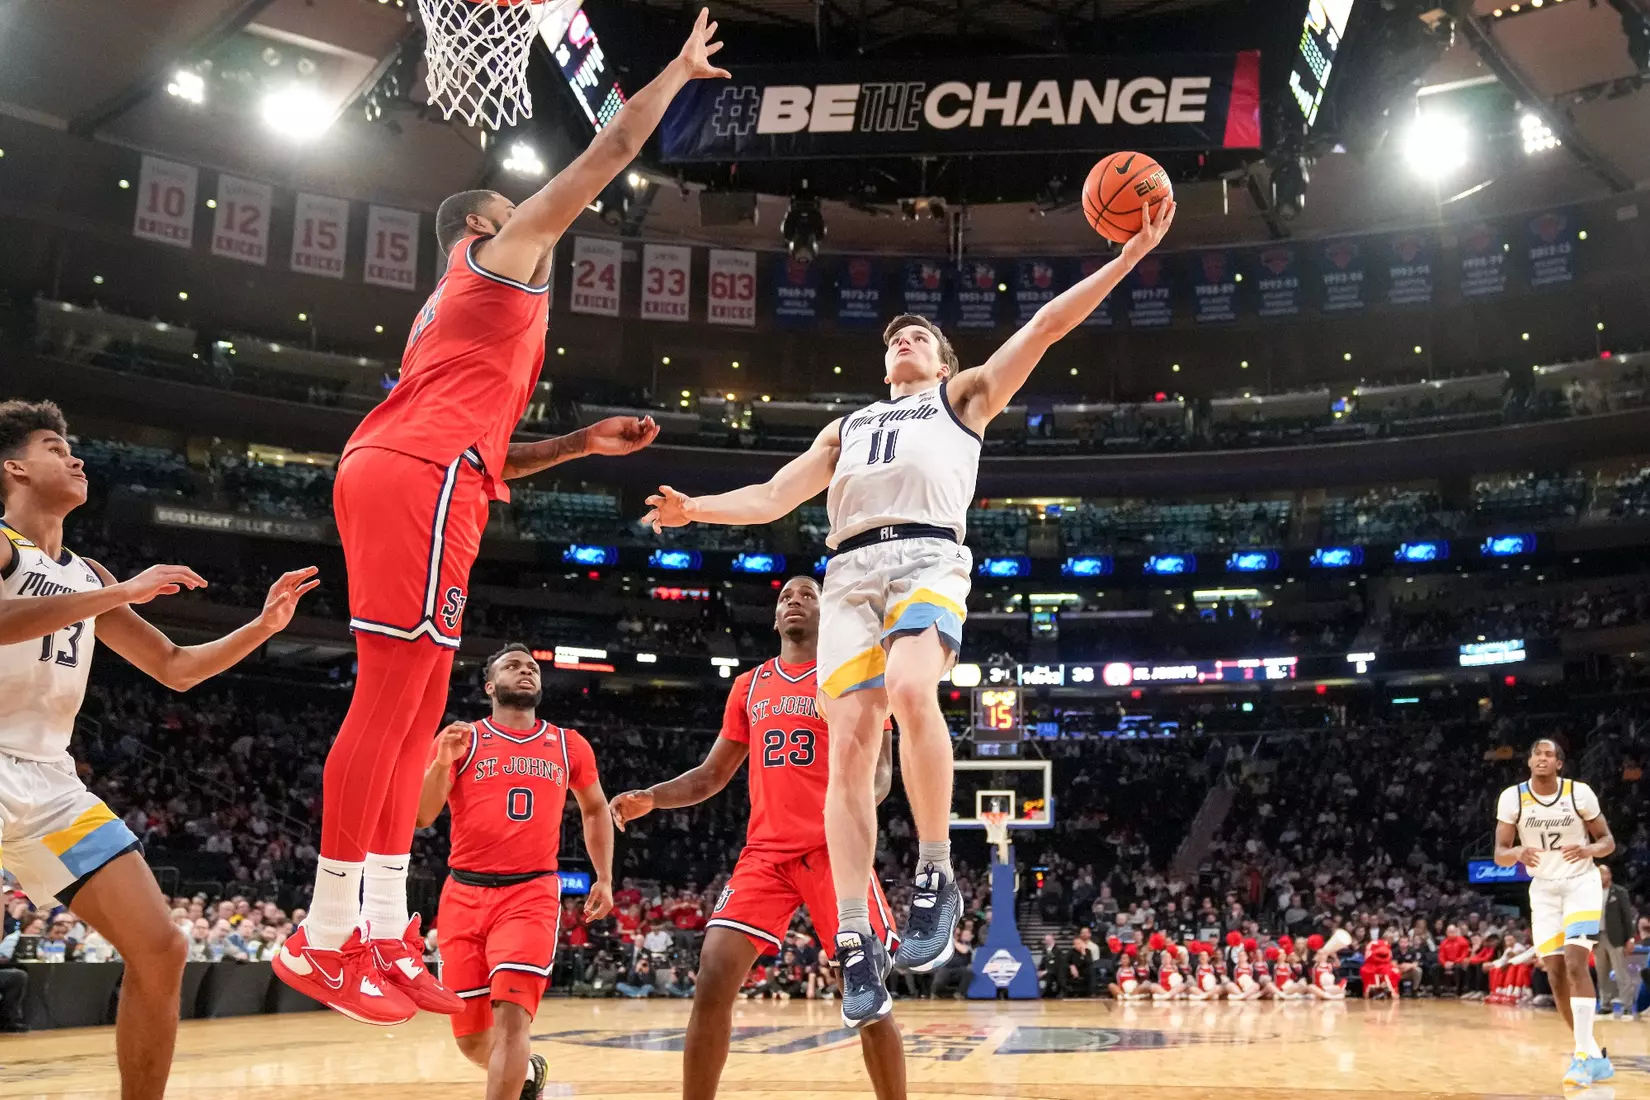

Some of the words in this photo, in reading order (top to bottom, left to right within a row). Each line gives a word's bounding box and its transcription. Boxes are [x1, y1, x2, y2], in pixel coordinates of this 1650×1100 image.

[146, 180, 186, 218] 10
[222, 202, 261, 237] 12
[303, 218, 337, 251] 15
[216, 236, 263, 258] KNICKS
[375, 229, 410, 263] 15
[295, 252, 341, 272] KNICKS
[367, 264, 413, 283] KNICKS
[577, 259, 616, 292] 24
[646, 267, 686, 297] 33
[711, 271, 754, 301] 613
[574, 293, 617, 310] KNICKS
[644, 300, 687, 316] KNICKS
[711, 304, 753, 320] KNICKS
[845, 404, 938, 437] Marquette
[867, 428, 899, 465] 11
[38, 619, 86, 668] 13
[751, 698, 771, 727] ST.
[990, 704, 1013, 729] 15
[763, 728, 816, 768] 23
[474, 757, 499, 781] ST.
[502, 755, 564, 787] JOHN'S
[506, 786, 534, 822] 0
[1525, 815, 1575, 829] Marquette
[1540, 833, 1562, 851] 12
